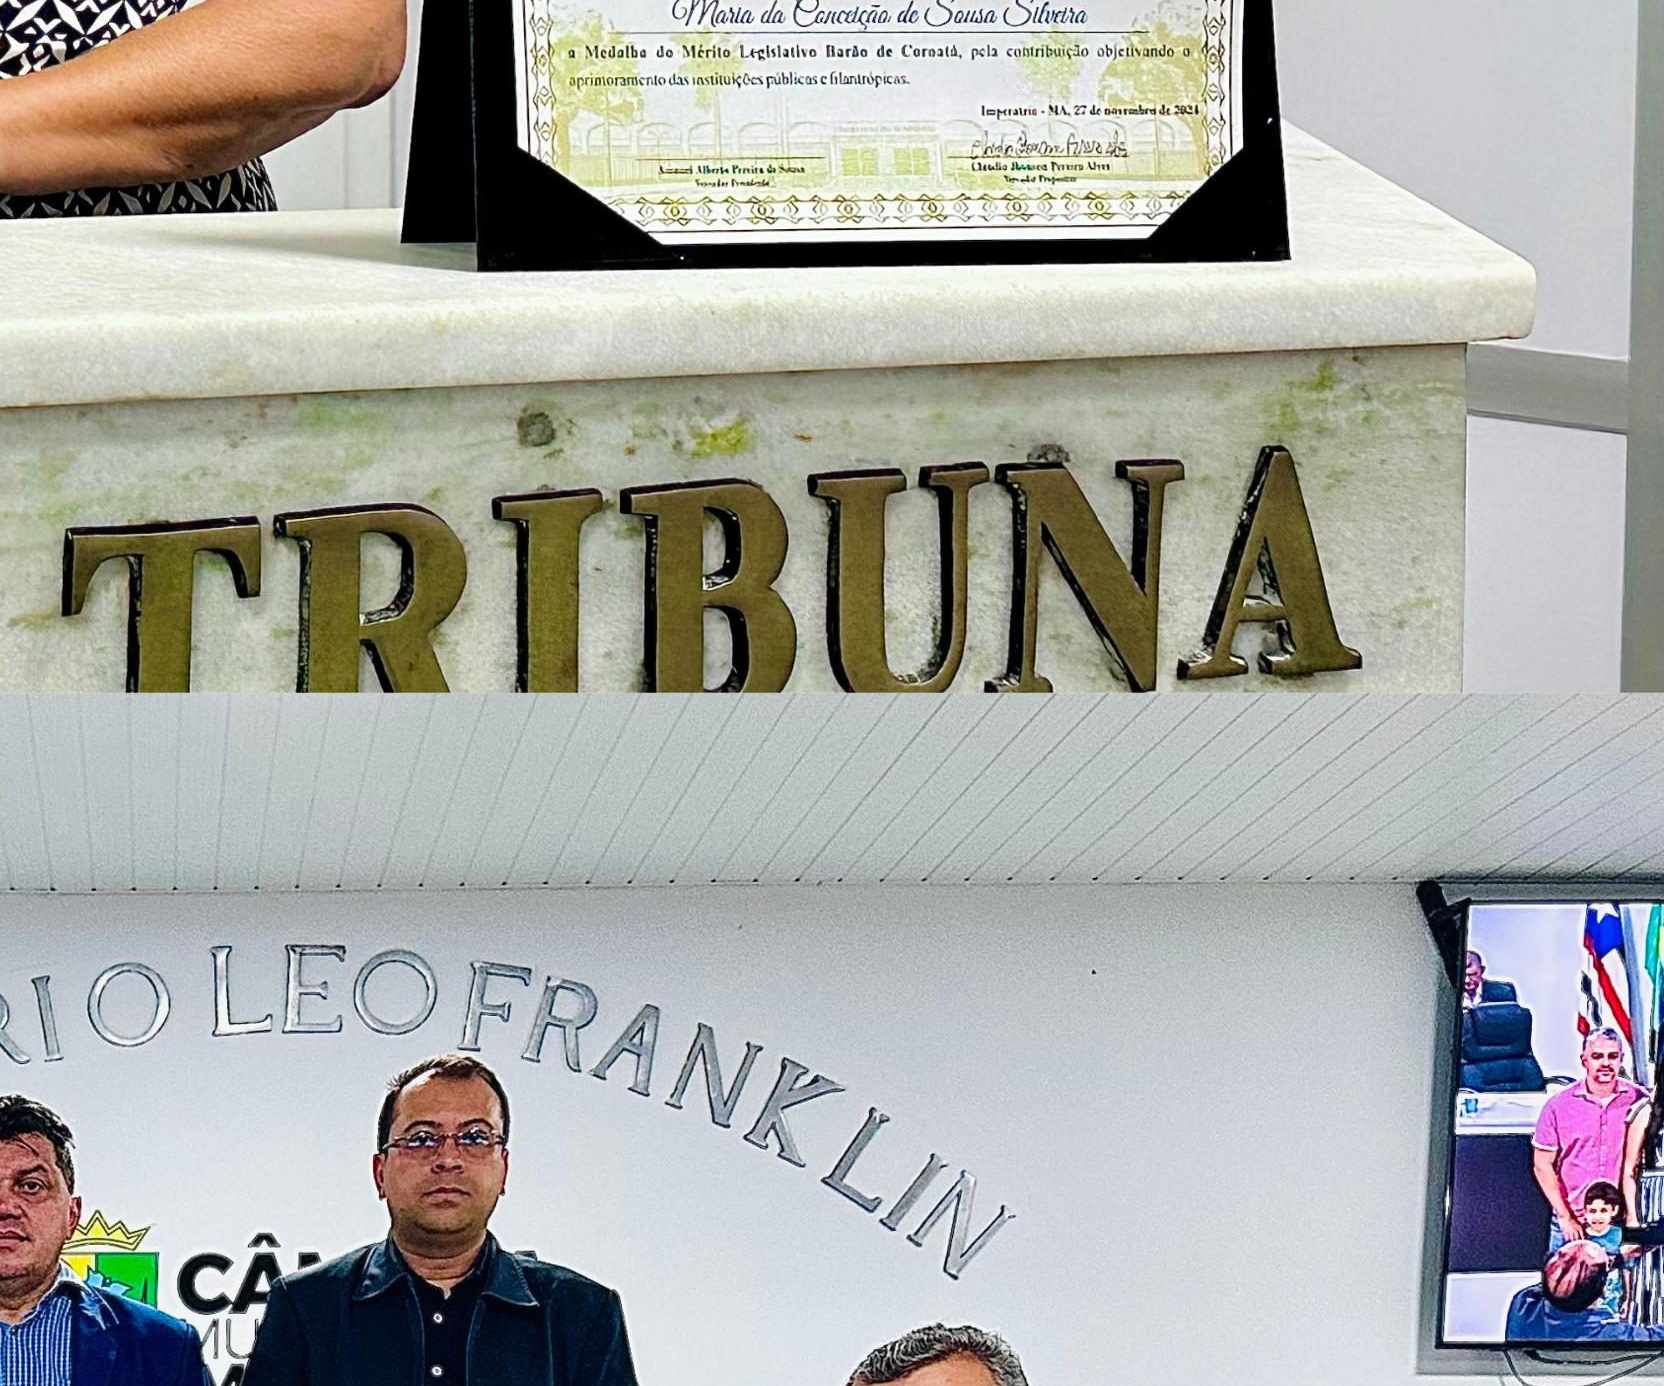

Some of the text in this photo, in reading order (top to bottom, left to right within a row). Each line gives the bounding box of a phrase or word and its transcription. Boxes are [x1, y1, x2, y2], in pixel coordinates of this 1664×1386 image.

[760, 0, 786, 24] da
[896, 0, 920, 24] de
[584, 44, 647, 59] Medalha
[655, 45, 674, 59] do
[682, 43, 731, 59] Mérito
[739, 44, 817, 62] Legislativo
[826, 44, 868, 59] Barão
[876, 44, 893, 59] de
[901, 43, 963, 60] Coroatá,
[971, 44, 999, 62] pela
[1006, 44, 1089, 62] contribuição
[1097, 43, 1175, 62] objetivando
[1182, 48, 1191, 59] o
[569, 74, 666, 90] aprimoramento
[668, 72, 690, 87] das
[692, 72, 764, 90] instituições
[766, 72, 818, 90] públicas
[820, 76, 827, 87] e
[1089, 104, 1101, 116] de
[1159, 104, 1171, 116] de
[61, 444, 1363, 694] TRIBUNA
[210, 942, 439, 1038] LEO
[457, 958, 1018, 1281] FRANKLIN
